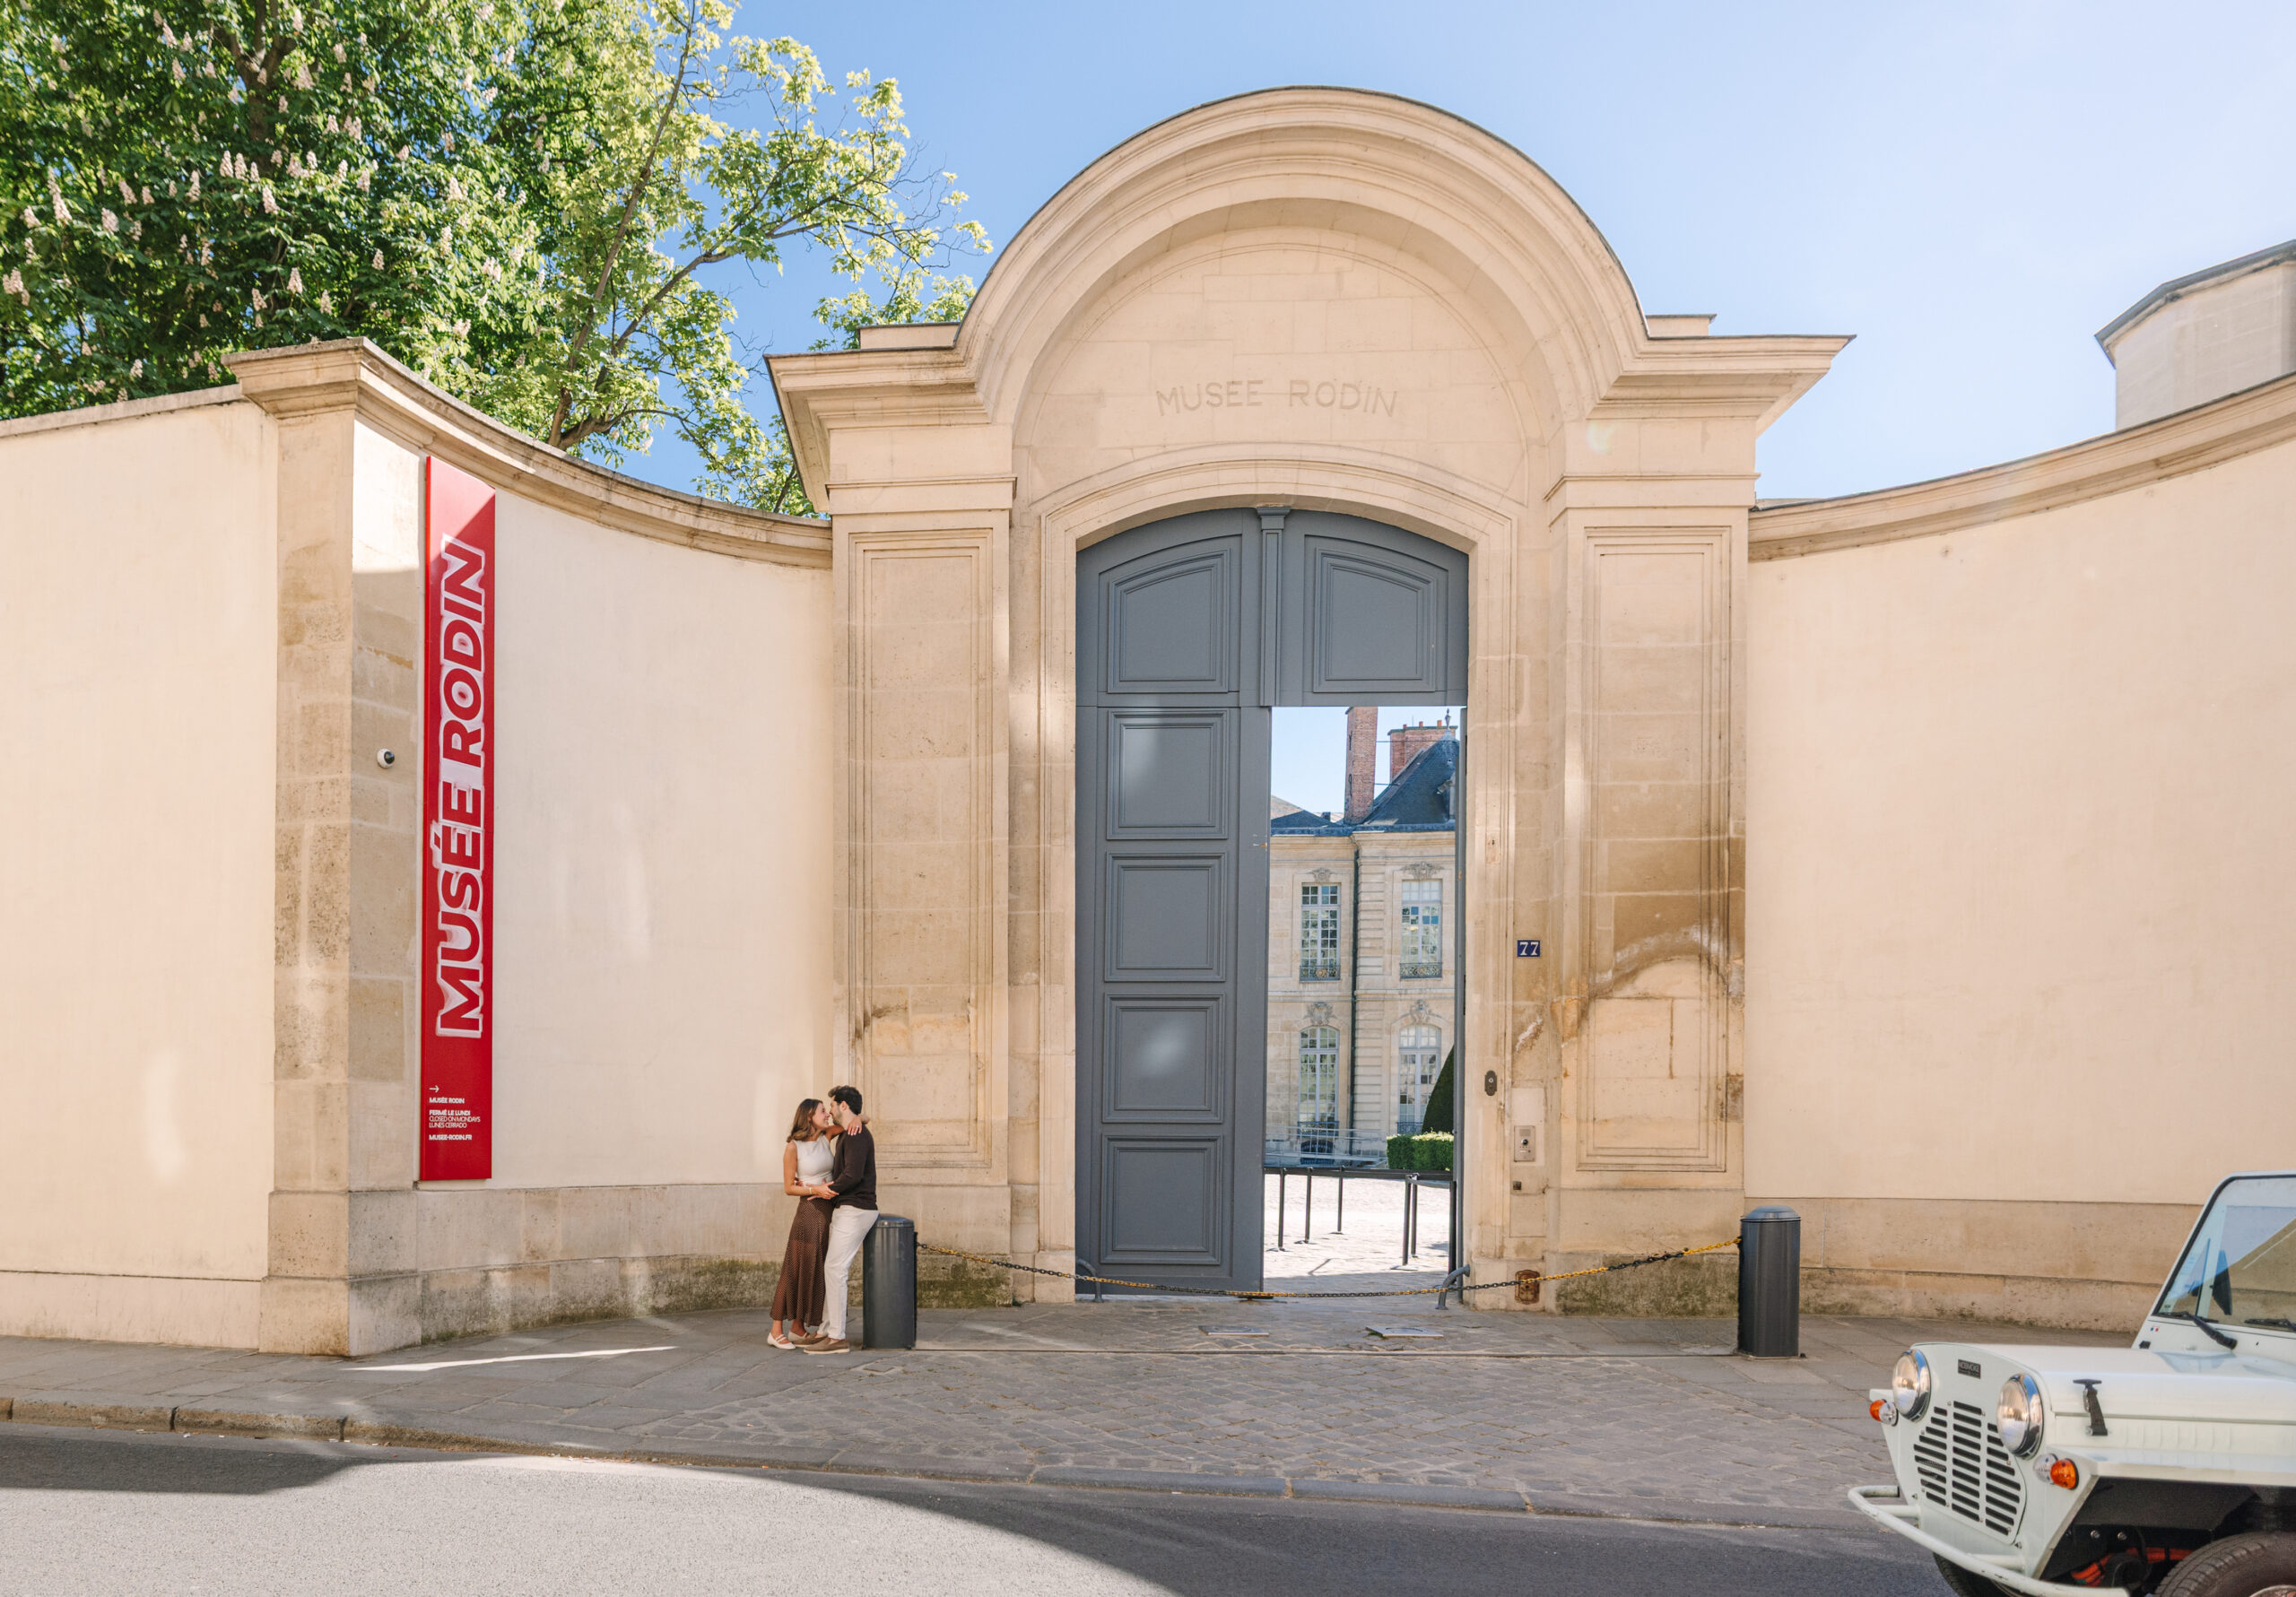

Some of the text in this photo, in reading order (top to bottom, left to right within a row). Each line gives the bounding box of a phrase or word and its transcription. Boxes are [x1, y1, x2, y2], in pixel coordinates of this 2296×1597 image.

[1156, 380, 1397, 417] MUSEE RODIN
[430, 534, 485, 1037] MUSÉE RODIN
[1519, 942, 1538, 956] 77
